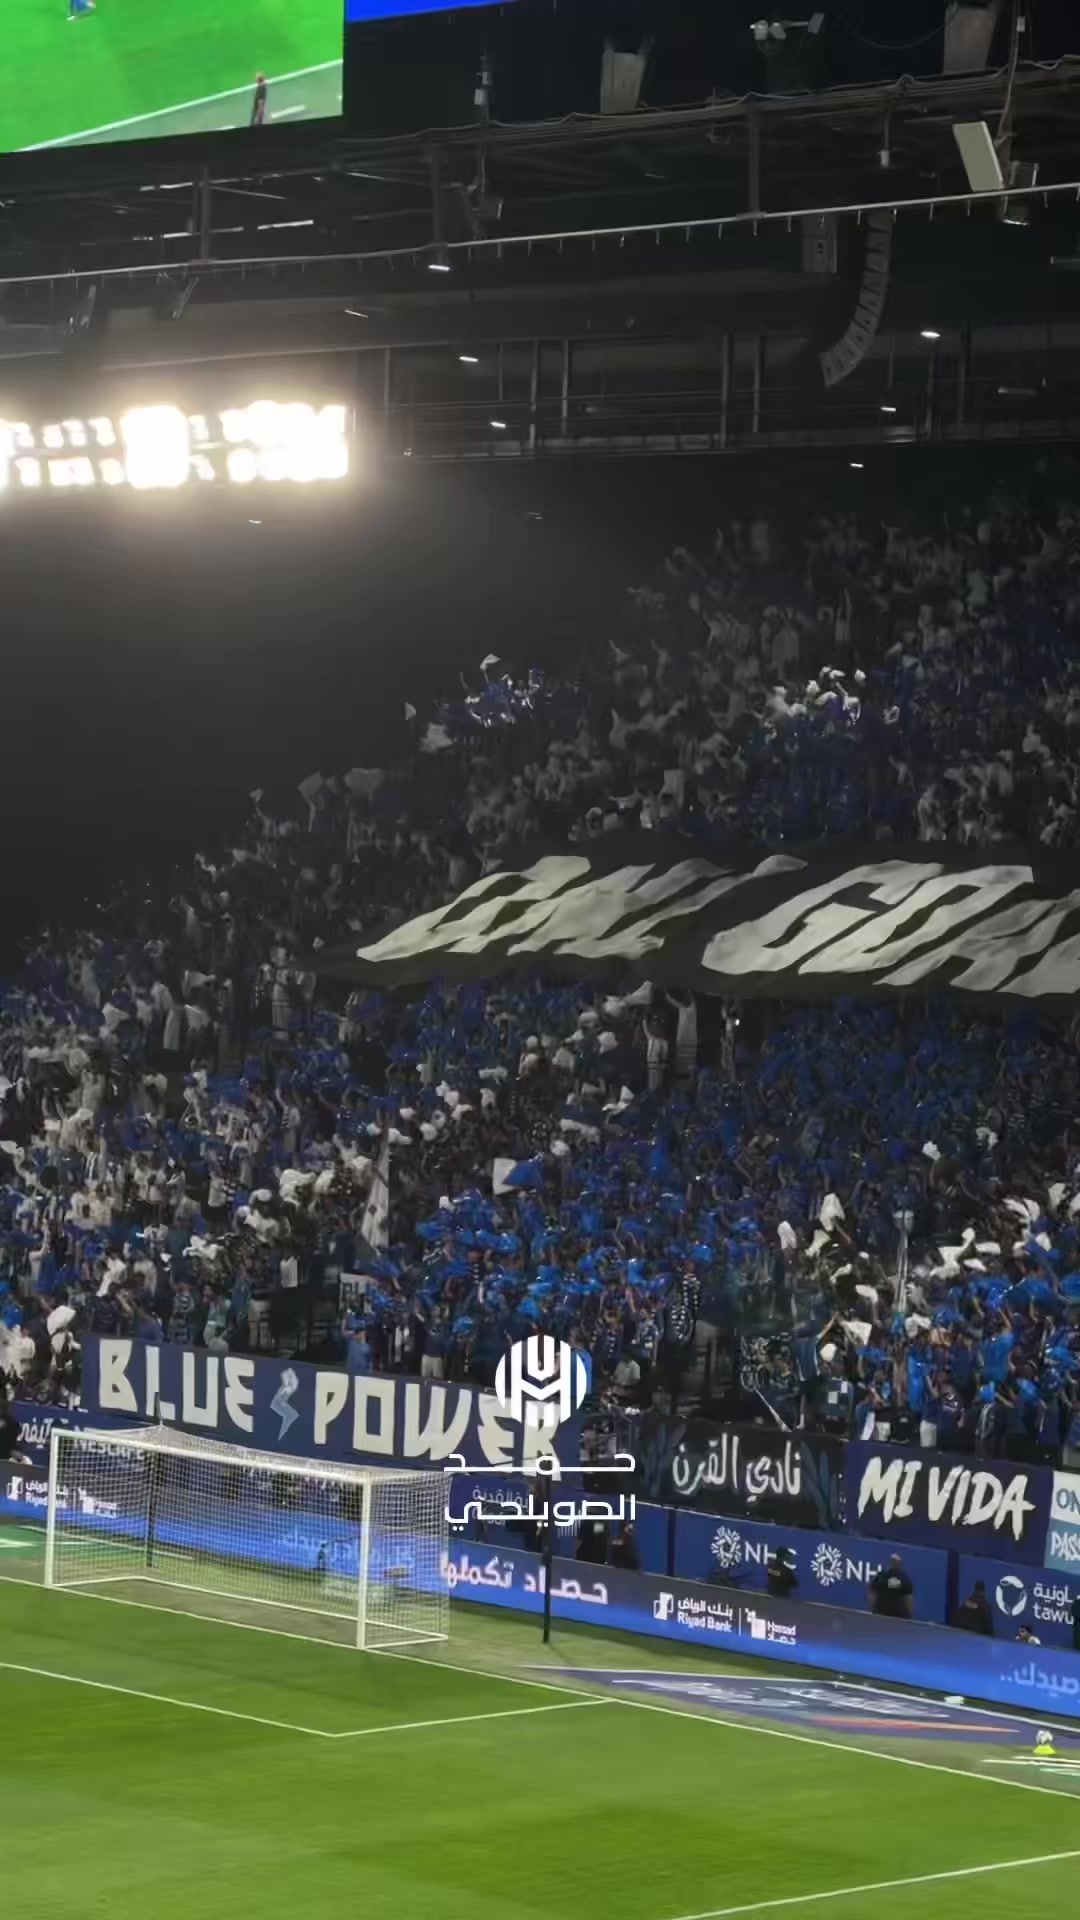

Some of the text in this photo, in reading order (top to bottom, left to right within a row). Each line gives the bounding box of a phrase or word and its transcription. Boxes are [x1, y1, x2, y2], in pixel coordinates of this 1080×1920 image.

[100, 1339, 560, 1480] BLUE POWER
[672, 1432, 801, 1503] نادي القرن
[857, 1456, 1036, 1541] MI VIDA
[524, 1566, 608, 1604] حصاد
[846, 1558, 882, 1584] NH
[678, 1611, 733, 1632] Riyad Bank
[1033, 1602, 1074, 1625] tawu
